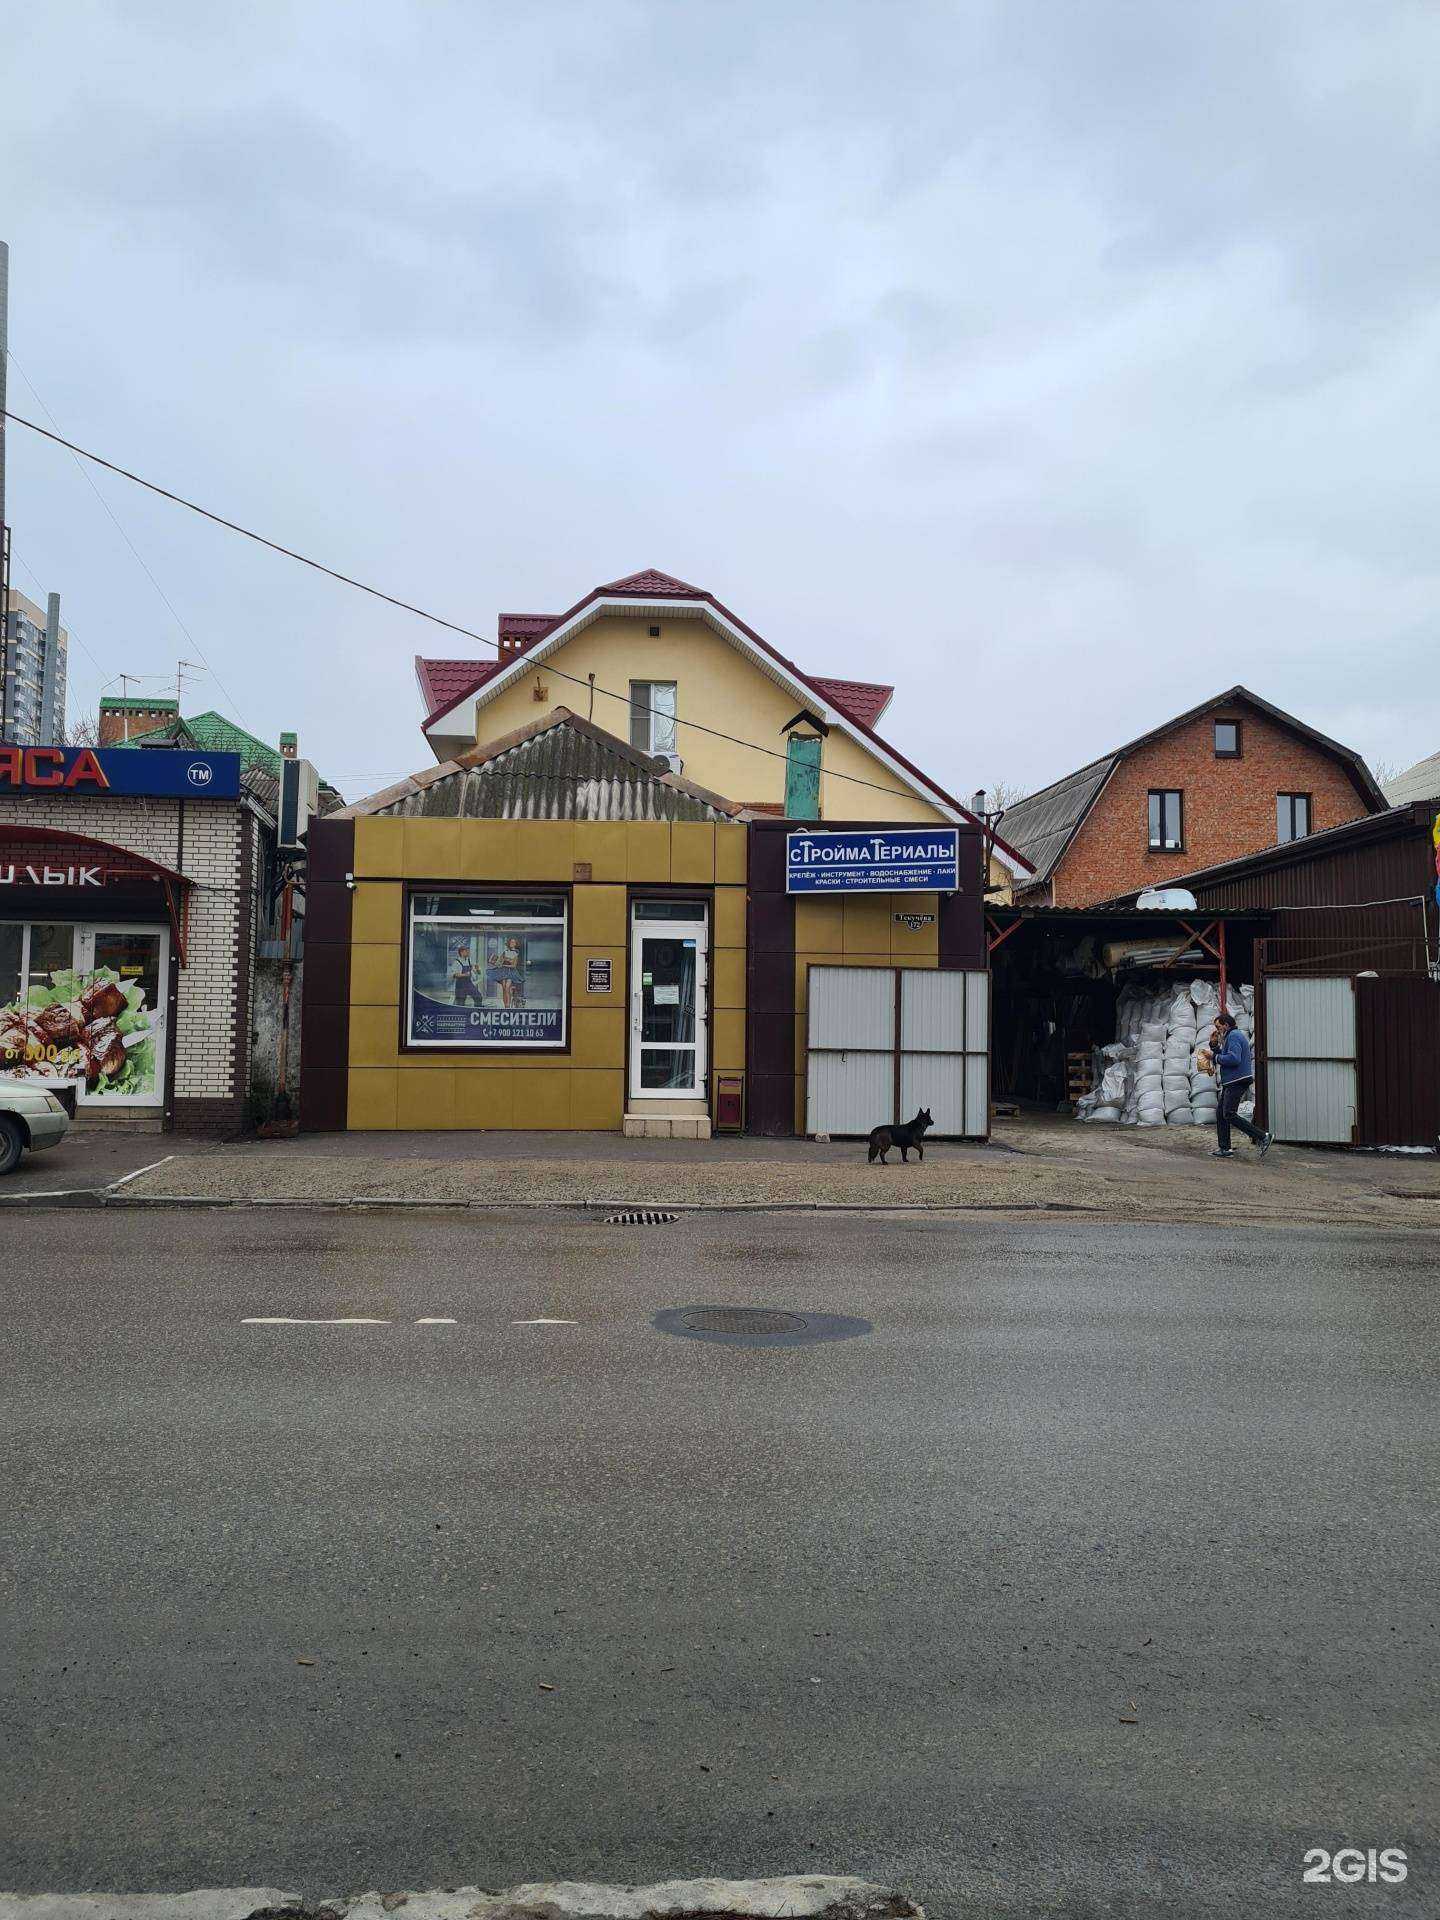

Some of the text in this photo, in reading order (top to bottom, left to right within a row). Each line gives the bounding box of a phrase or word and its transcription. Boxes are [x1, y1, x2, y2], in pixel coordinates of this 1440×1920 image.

[190, 769, 210, 781] TM
[790, 838, 954, 863] СТРОЙМАТЕРИАЛЫ
[821, 870, 866, 878] ИНСТРУМЕНТ
[870, 868, 932, 877] ВОДОСНАБЖЕНИЕ
[845, 876, 901, 884] СТРОИТЕЛЬНЫЕ
[470, 1012, 557, 1026] СМЕСИТЕЛИ
